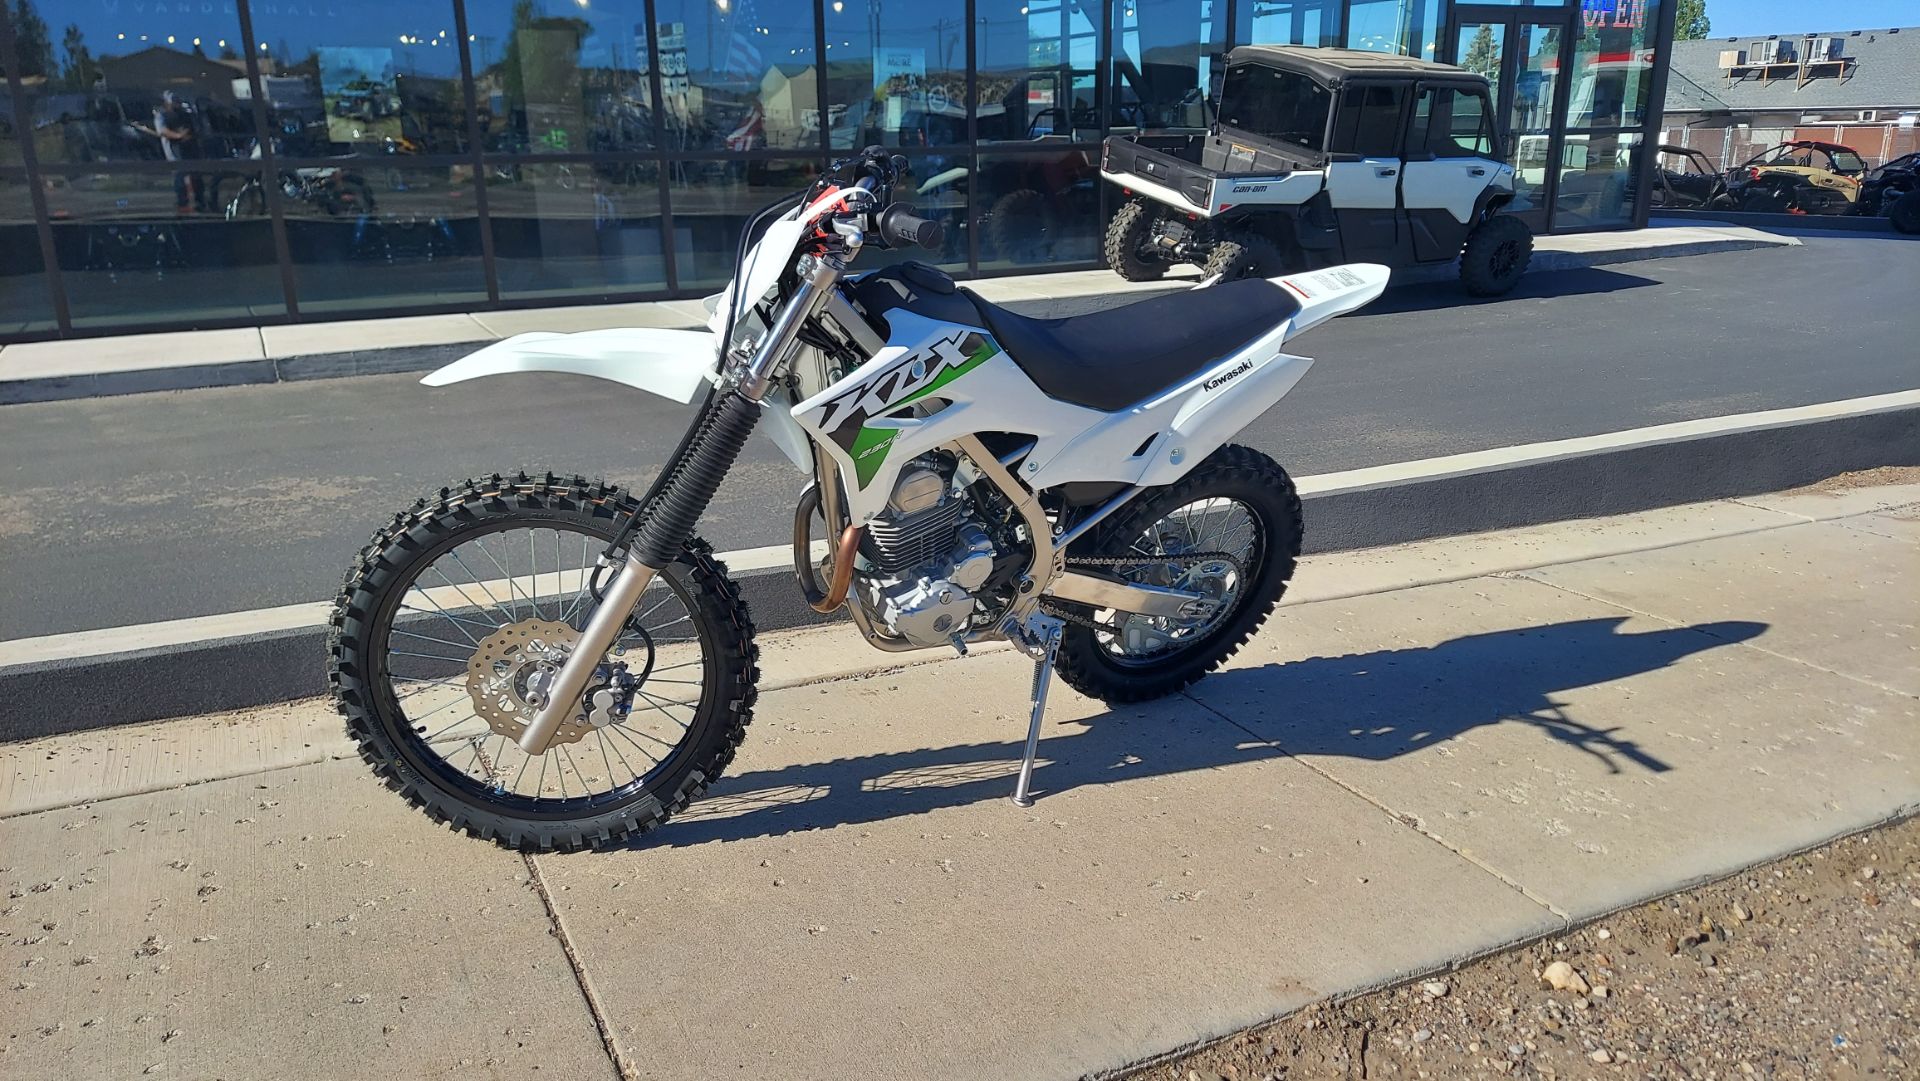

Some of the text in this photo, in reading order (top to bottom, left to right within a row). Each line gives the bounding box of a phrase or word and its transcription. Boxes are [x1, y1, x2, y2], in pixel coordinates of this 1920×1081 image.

[1583, 0, 1645, 28] OPEN
[818, 330, 972, 434] KLX
[1203, 358, 1254, 392] Kawasaki
